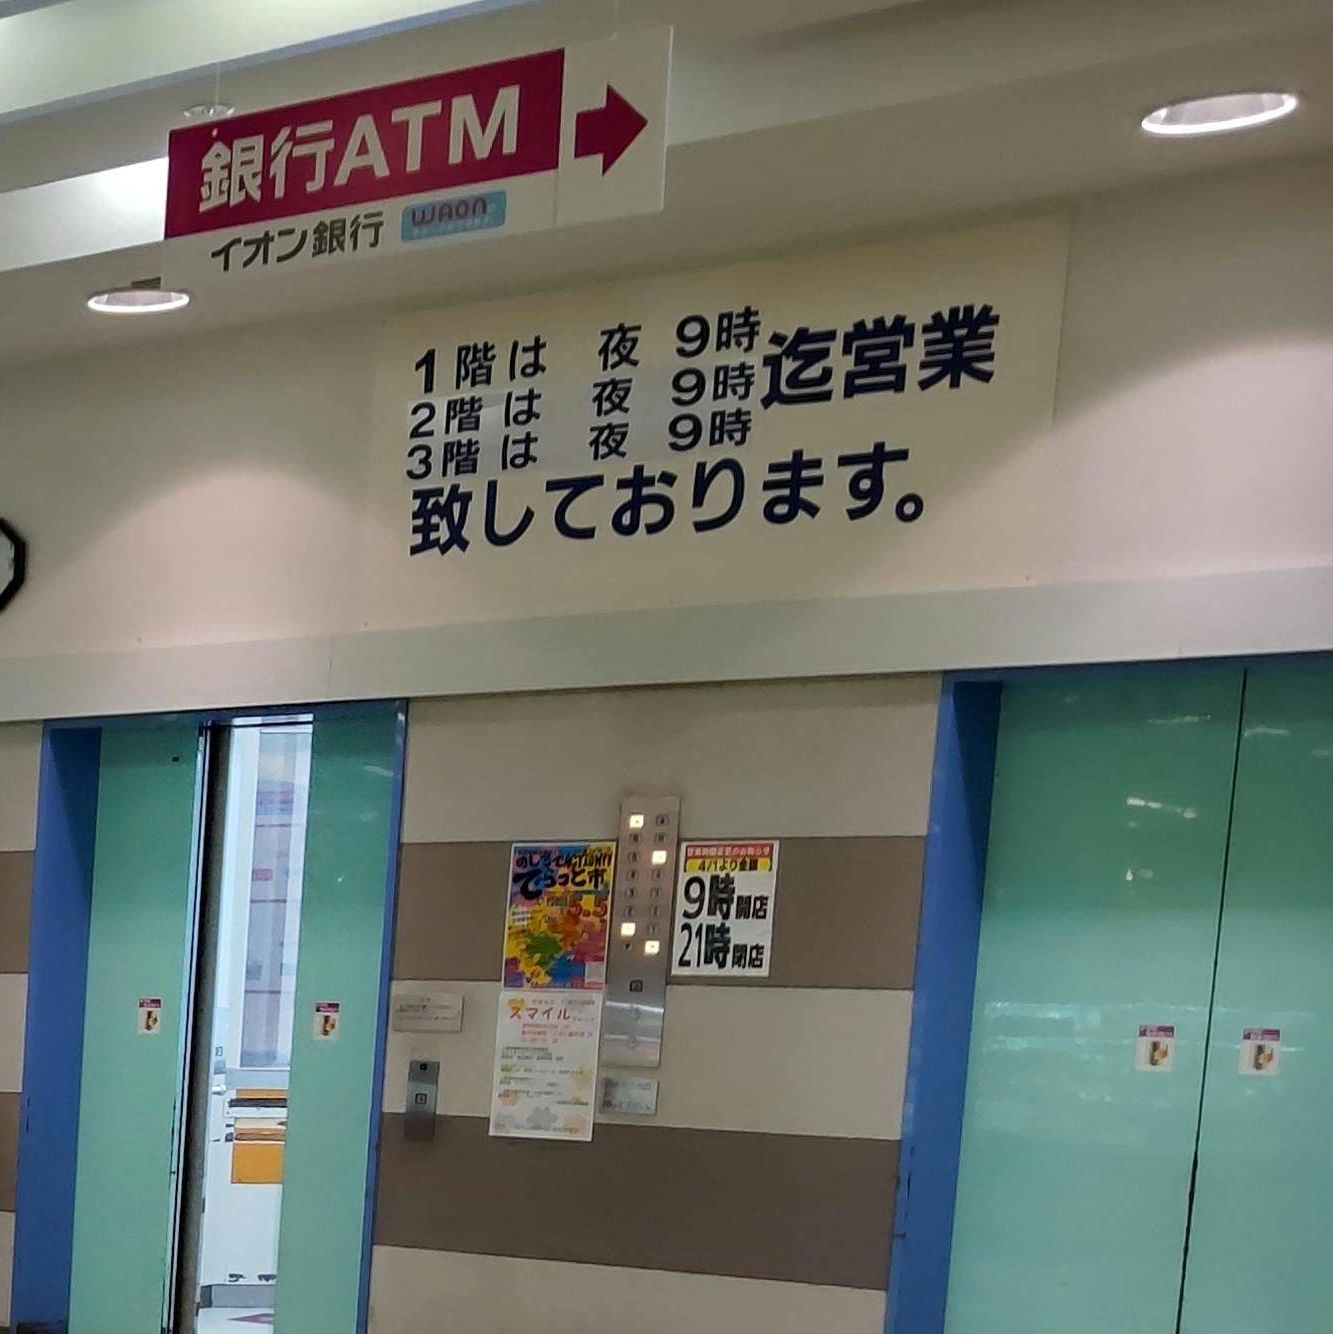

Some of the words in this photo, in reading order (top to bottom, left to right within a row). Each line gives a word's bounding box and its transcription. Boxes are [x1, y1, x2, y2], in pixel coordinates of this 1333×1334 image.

[199, 84, 521, 214] 銀行ATM
[210, 211, 385, 272] イオン銀行
[600, 323, 642, 372] 夜
[593, 376, 634, 418] 夜
[589, 423, 629, 462] 夜
[409, 440, 925, 558] 致しております。
[509, 1006, 571, 1020] スマイル
